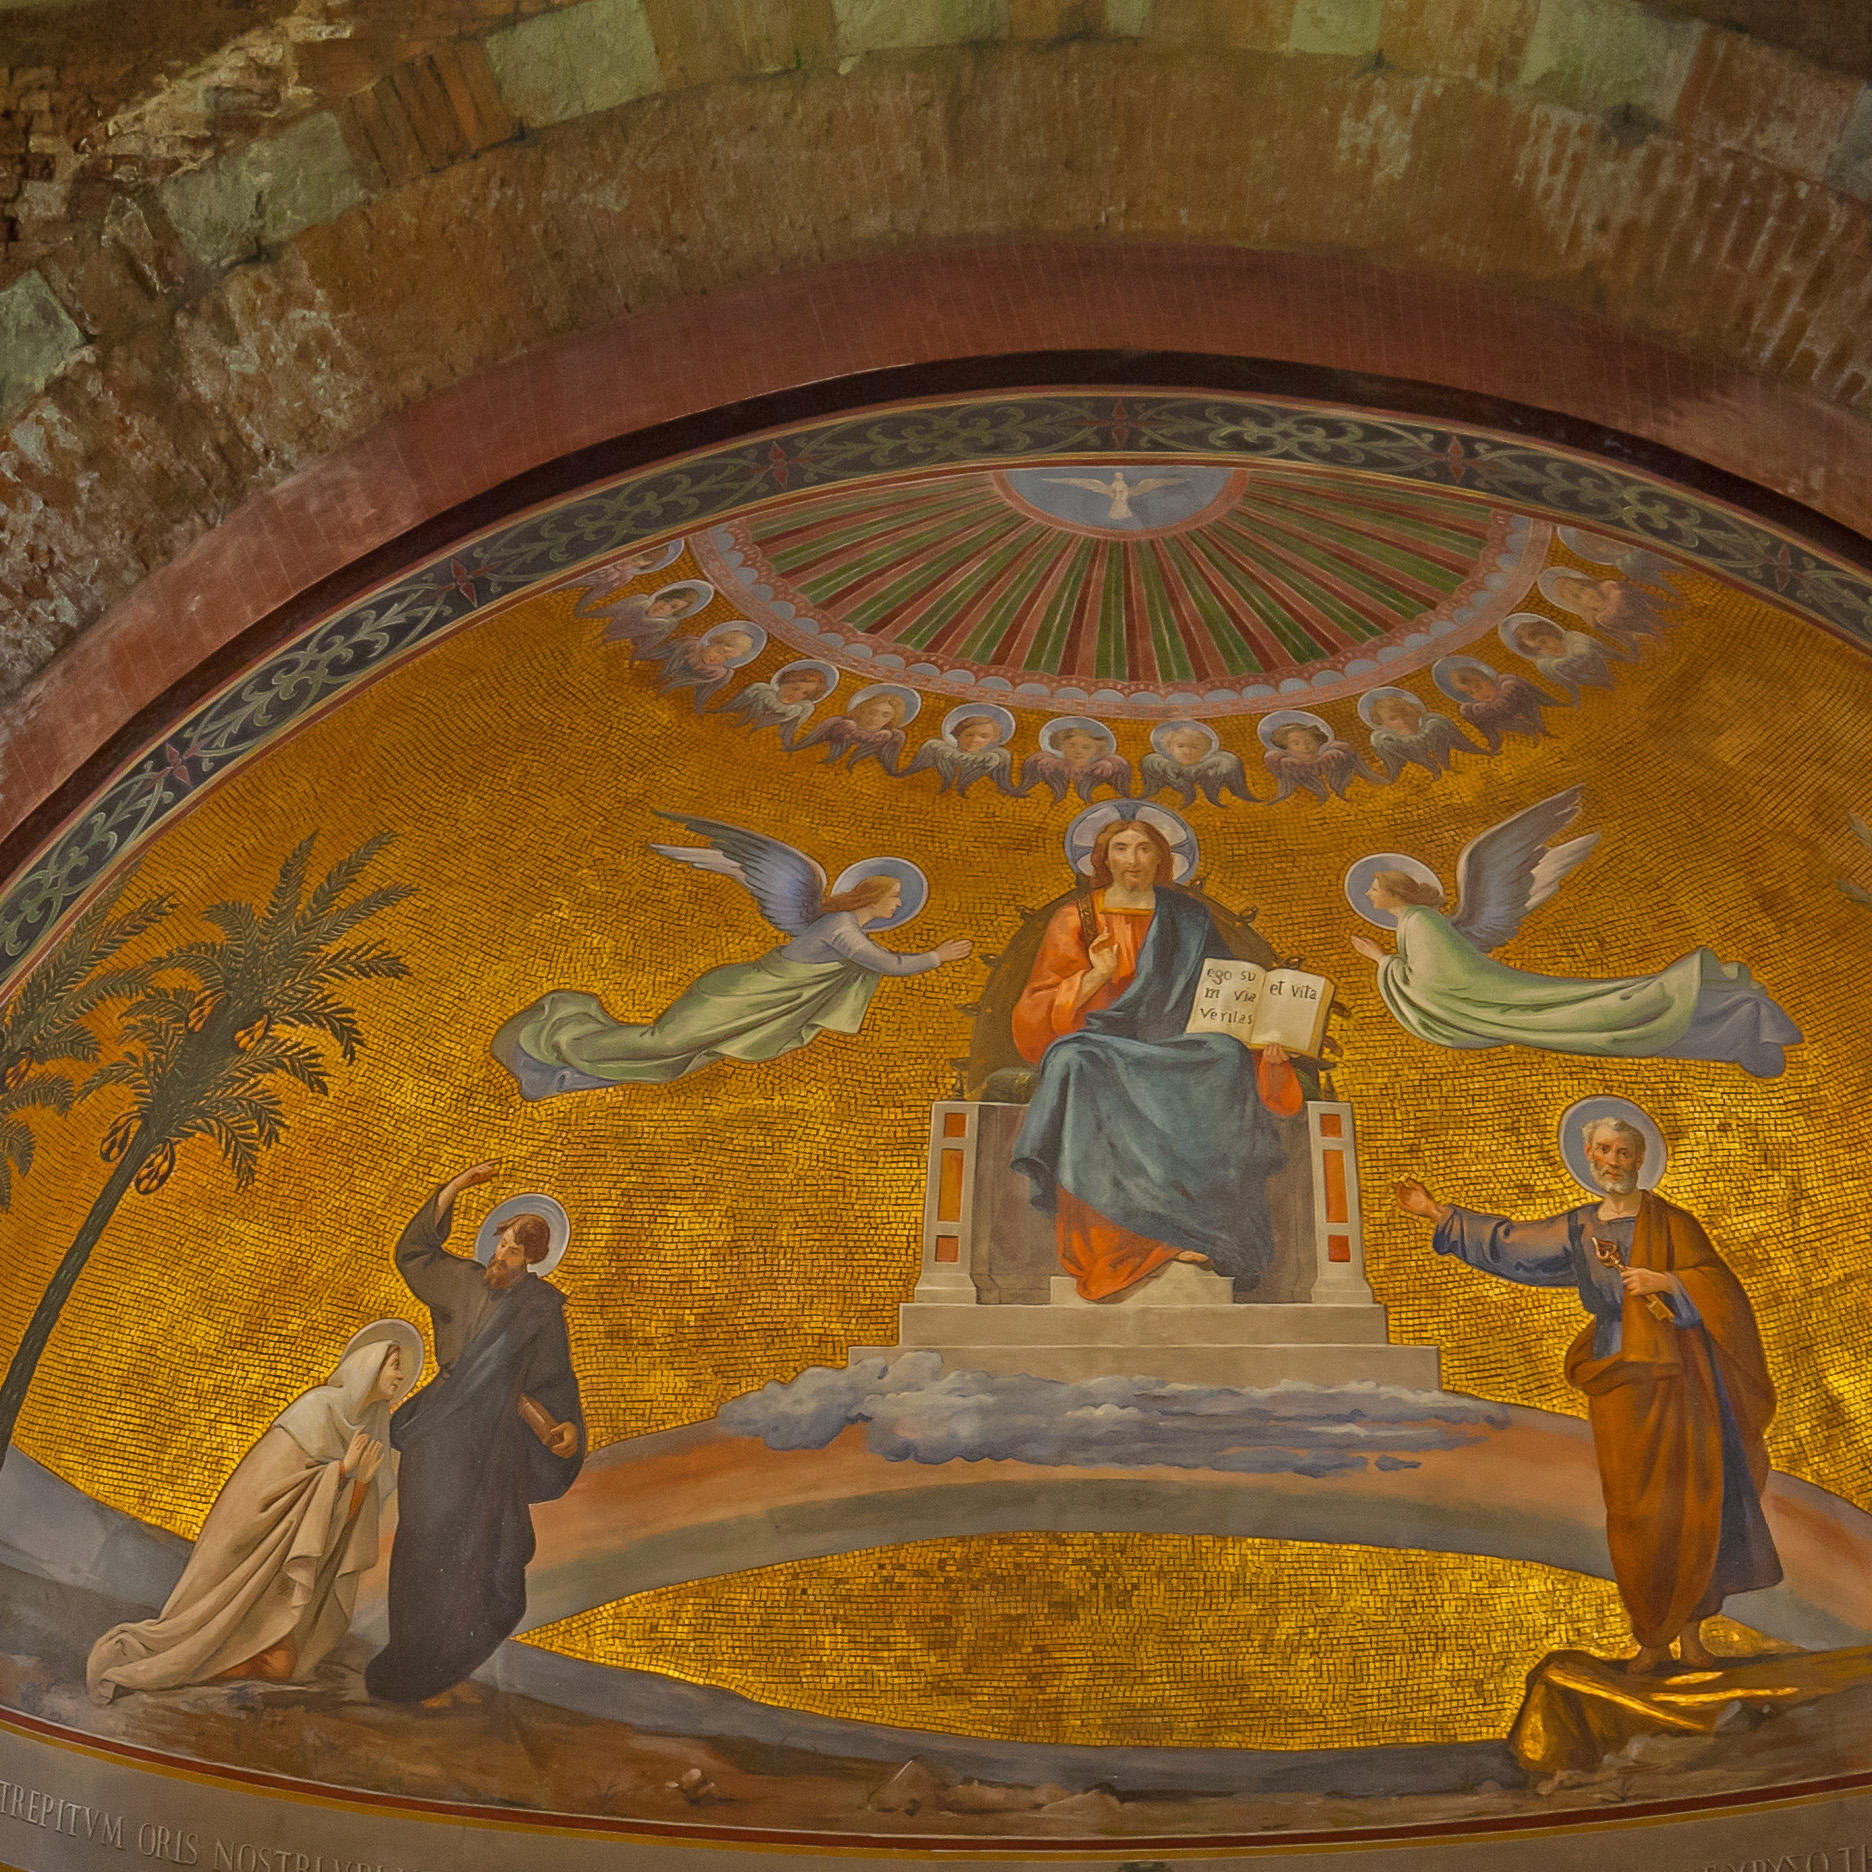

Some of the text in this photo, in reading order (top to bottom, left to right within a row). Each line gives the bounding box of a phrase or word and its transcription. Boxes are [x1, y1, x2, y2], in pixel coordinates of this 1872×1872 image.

[1206, 968, 1233, 985] ego
[1204, 987, 1256, 1002] m via
[1269, 980, 1317, 1000] et vita
[137, 1822, 200, 1866] ORIS
